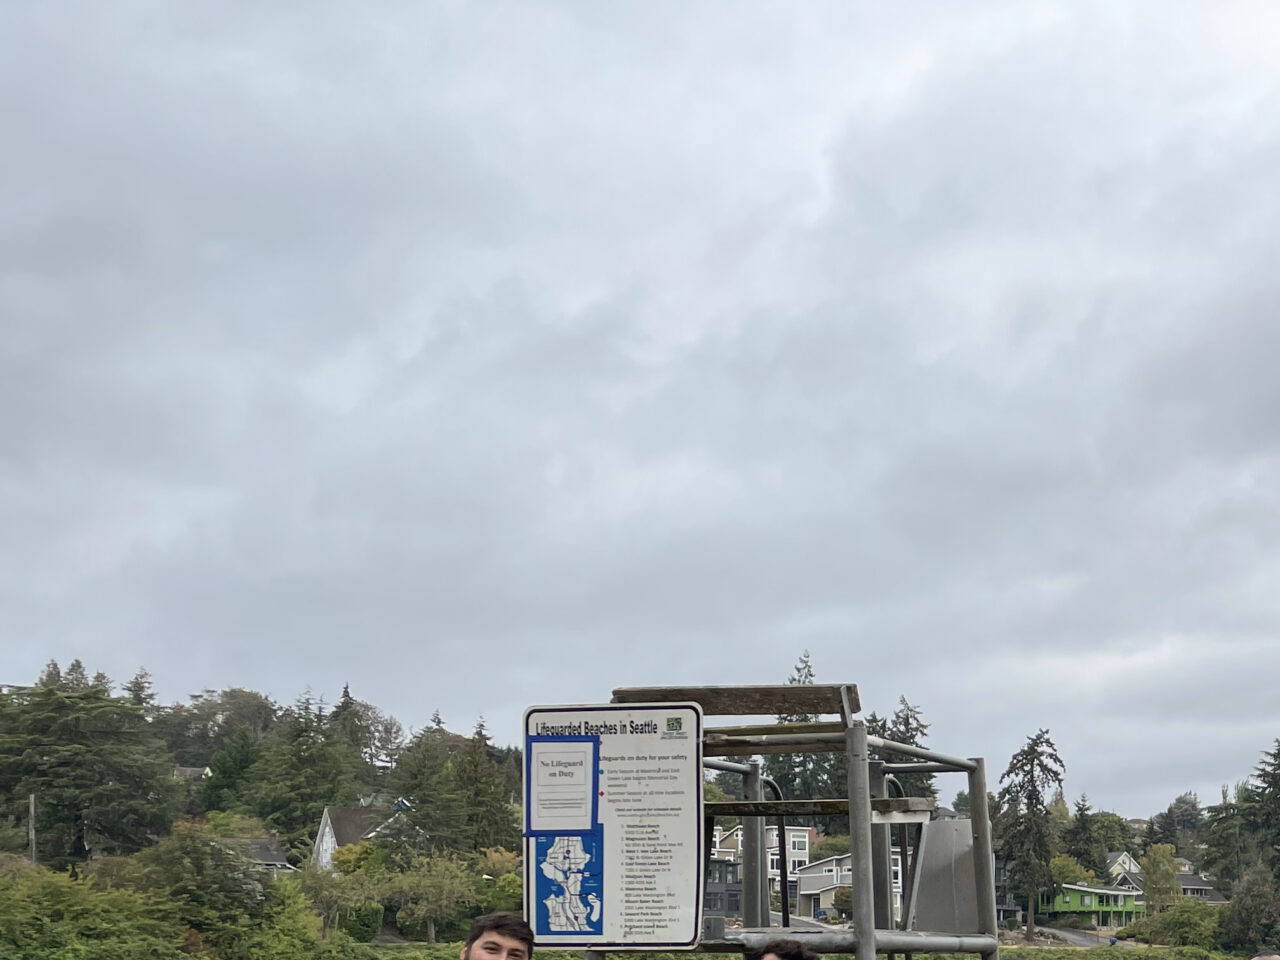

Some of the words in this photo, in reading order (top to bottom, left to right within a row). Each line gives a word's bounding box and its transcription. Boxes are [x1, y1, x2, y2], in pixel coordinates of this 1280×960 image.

[536, 722, 582, 735] Lifeguarded
[584, 721, 618, 735] Beaches
[620, 720, 626, 734] in
[629, 720, 658, 734] Seattle
